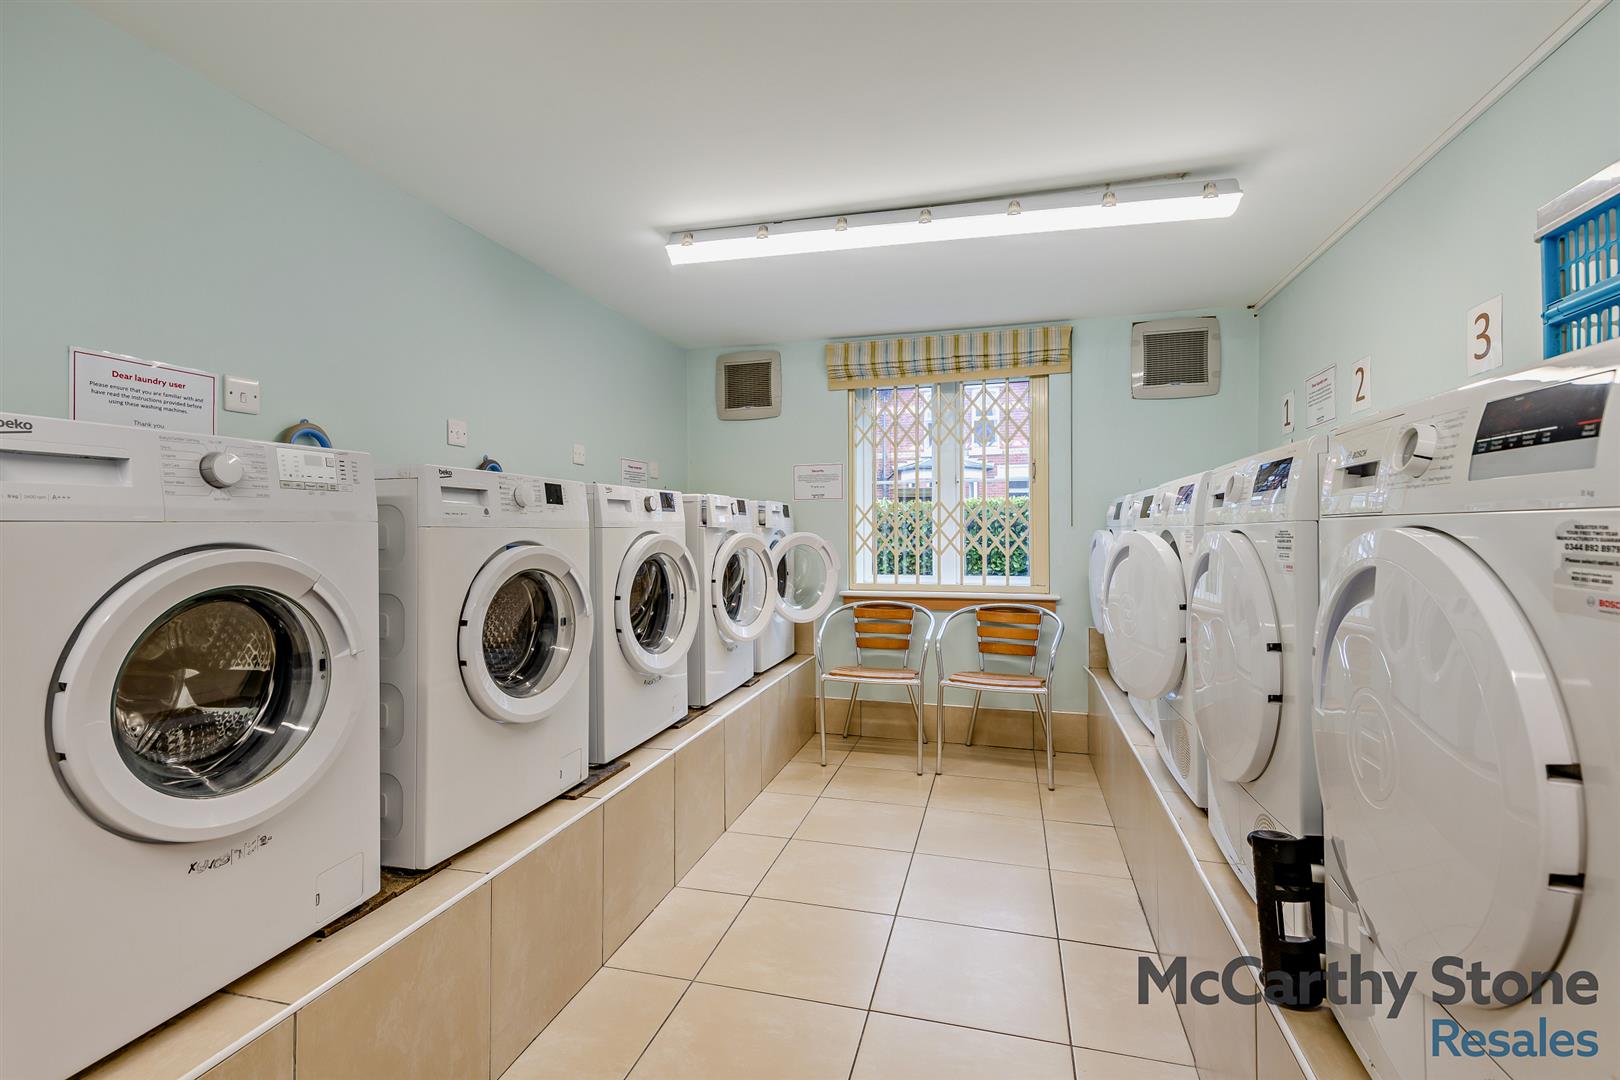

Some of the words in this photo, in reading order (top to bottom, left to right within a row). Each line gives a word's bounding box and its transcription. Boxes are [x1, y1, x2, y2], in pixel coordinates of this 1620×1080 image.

[1474, 312, 1491, 360] 3
[89, 380, 108, 389] Please
[129, 386, 141, 394] that
[141, 389, 152, 397] you
[162, 391, 182, 400] familiar
[111, 370, 132, 381] Dear
[134, 374, 167, 388] laundry
[168, 382, 186, 390] user
[1355, 367, 1365, 402] 2
[90, 388, 106, 396] have
[106, 390, 120, 398] read
[131, 393, 162, 404] instructions
[163, 398, 186, 408] provided
[186, 401, 203, 410] before
[108, 399, 124, 407] using
[124, 400, 140, 408] these
[140, 404, 162, 413] washing
[1283, 399, 1291, 427] 1
[133, 419, 152, 428] Thank
[153, 422, 165, 430] you
[438, 468, 453, 477] beko
[1564, 543, 1583, 551] 0344
[1584, 544, 1599, 552] 892
